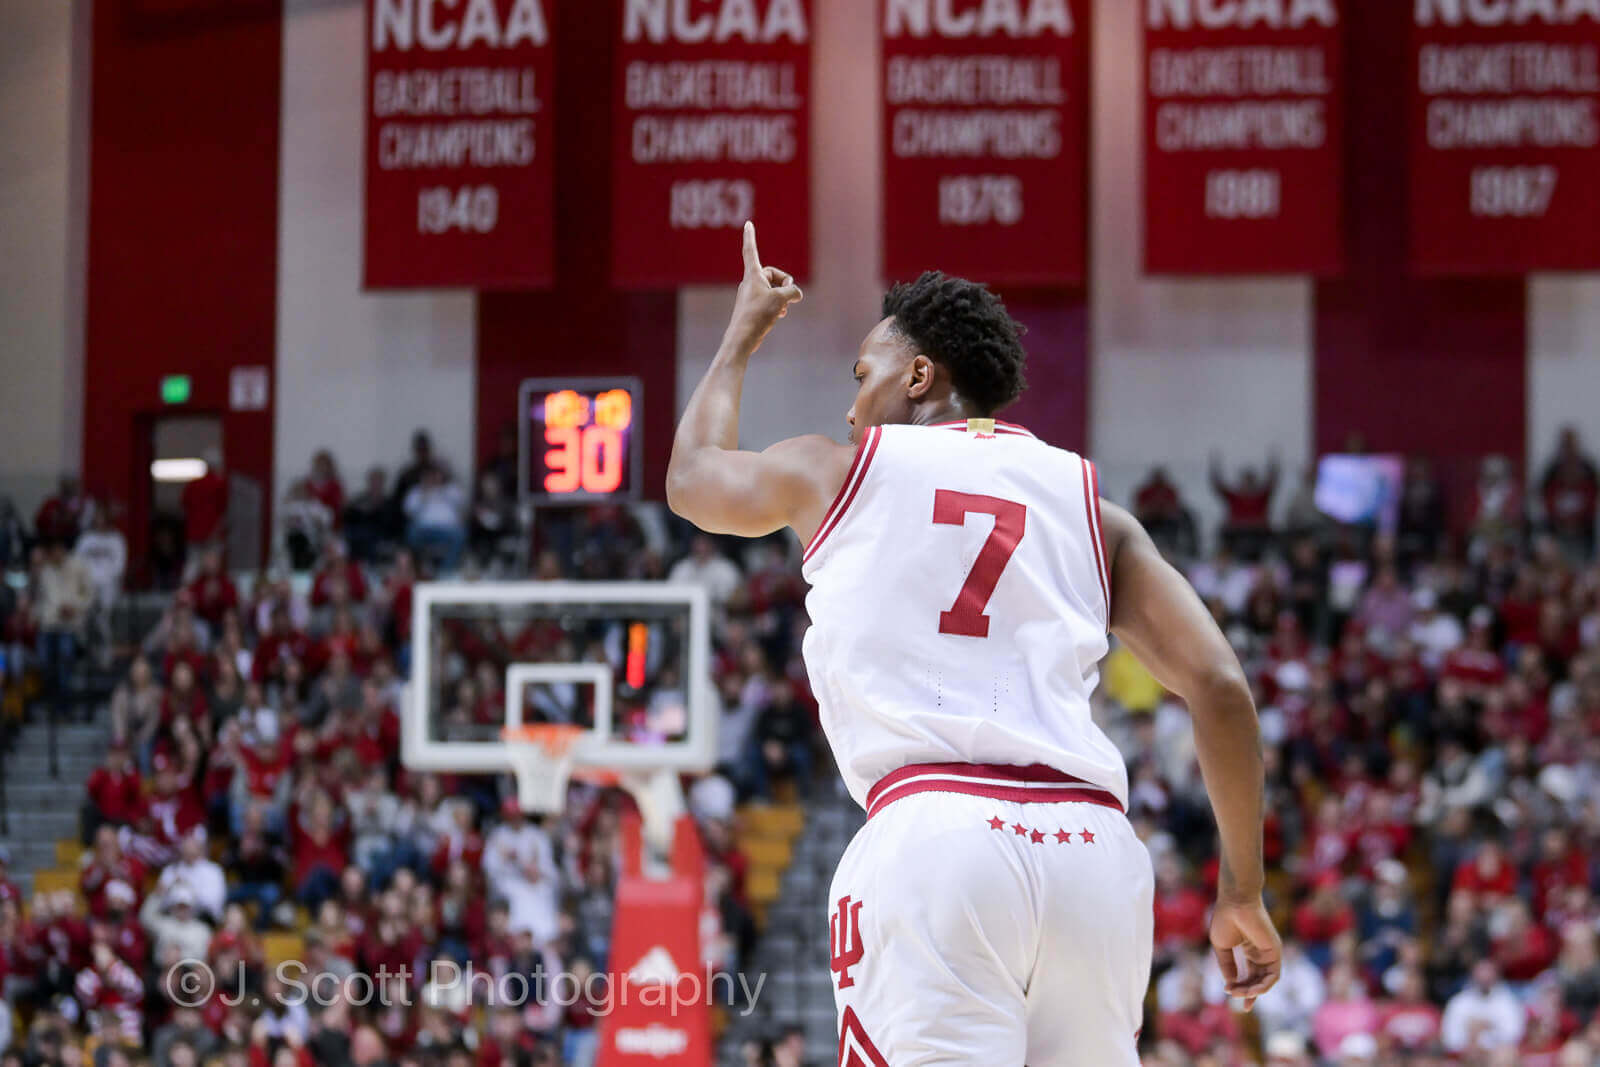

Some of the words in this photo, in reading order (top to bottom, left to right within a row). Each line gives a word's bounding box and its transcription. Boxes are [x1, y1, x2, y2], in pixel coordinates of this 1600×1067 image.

[372, 0, 548, 50] NCAA
[624, 0, 808, 43] NCAA
[373, 68, 540, 117] BASKETBALL
[626, 61, 799, 109] BASKETBALL
[885, 56, 1063, 104] BASKETBALL
[1149, 47, 1326, 97] BASKETBALL
[379, 119, 534, 168] CHAMPIONS
[632, 115, 795, 163] CHAMPIONS
[893, 110, 1060, 158] CHAMPIONS
[1157, 101, 1324, 150] CHAMPIONS
[418, 186, 498, 233] 1940
[670, 180, 754, 228] 1953
[544, 425, 622, 493] 30
[933, 488, 1027, 638] 7
